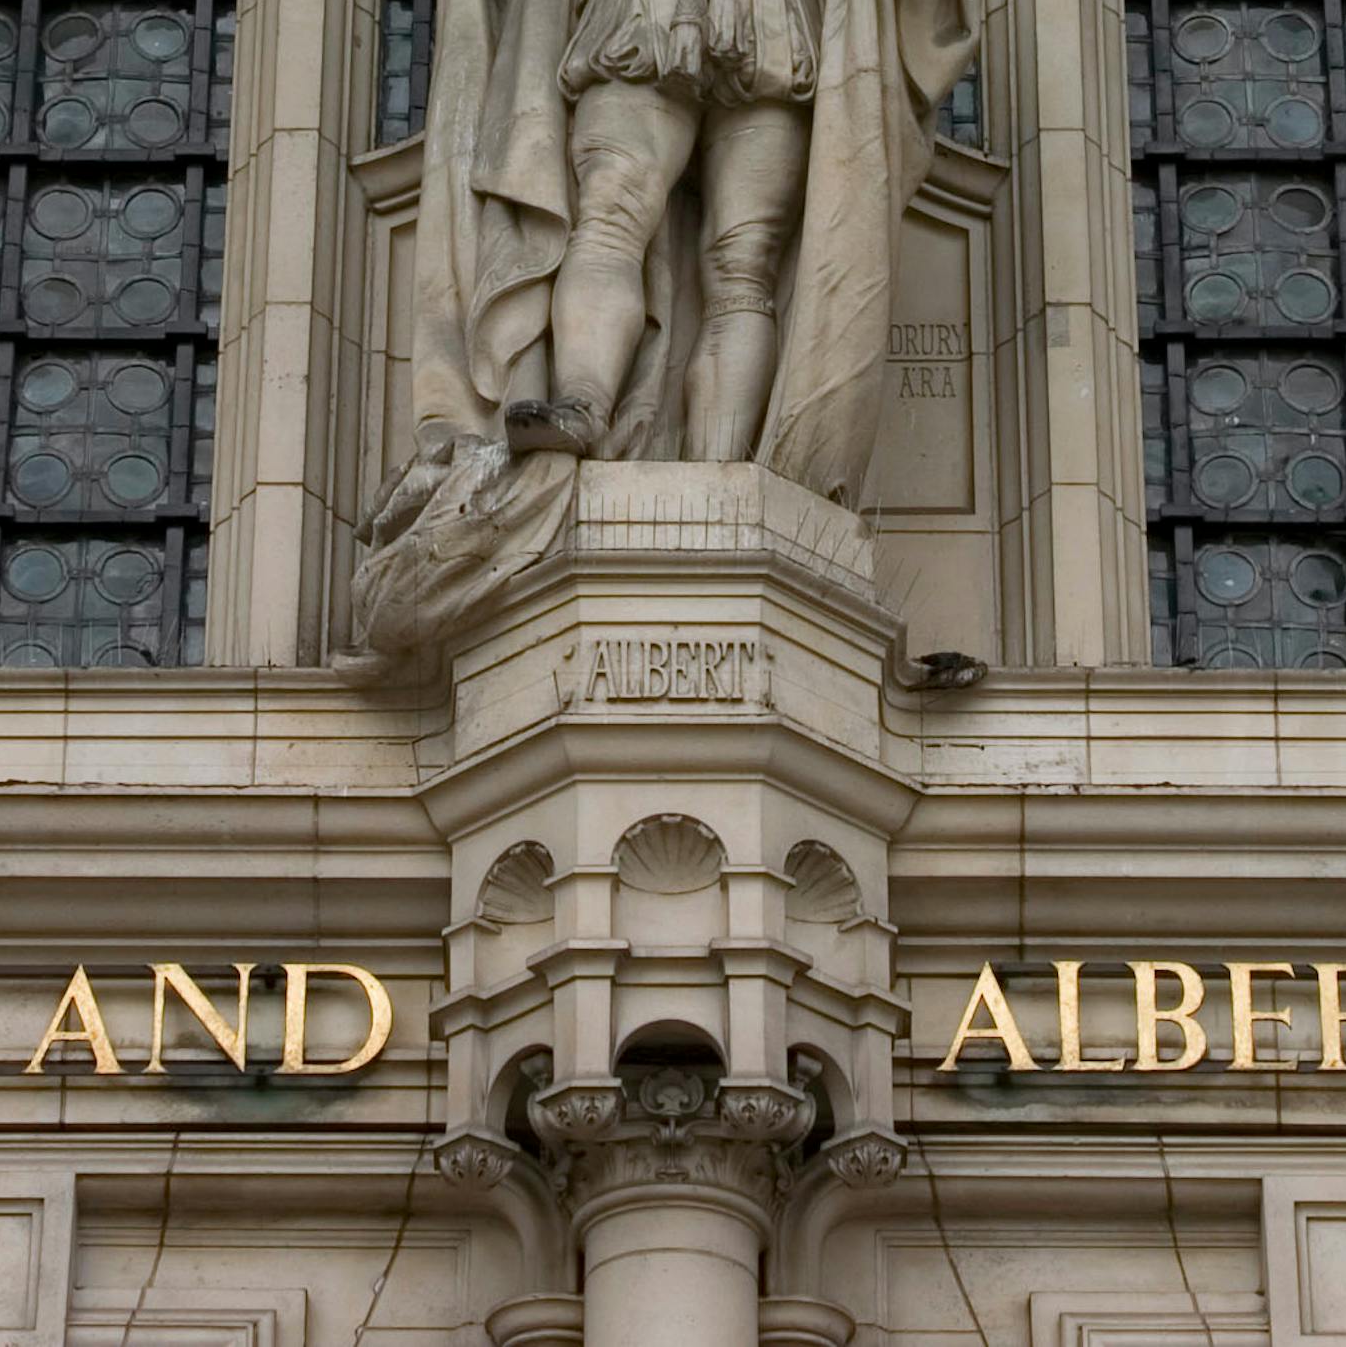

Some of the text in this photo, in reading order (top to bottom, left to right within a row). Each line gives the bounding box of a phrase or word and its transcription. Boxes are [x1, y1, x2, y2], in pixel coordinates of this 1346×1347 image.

[888, 323, 968, 356] DRURY
[585, 640, 755, 703] ALBERT
[23, 962, 393, 1074] AND
